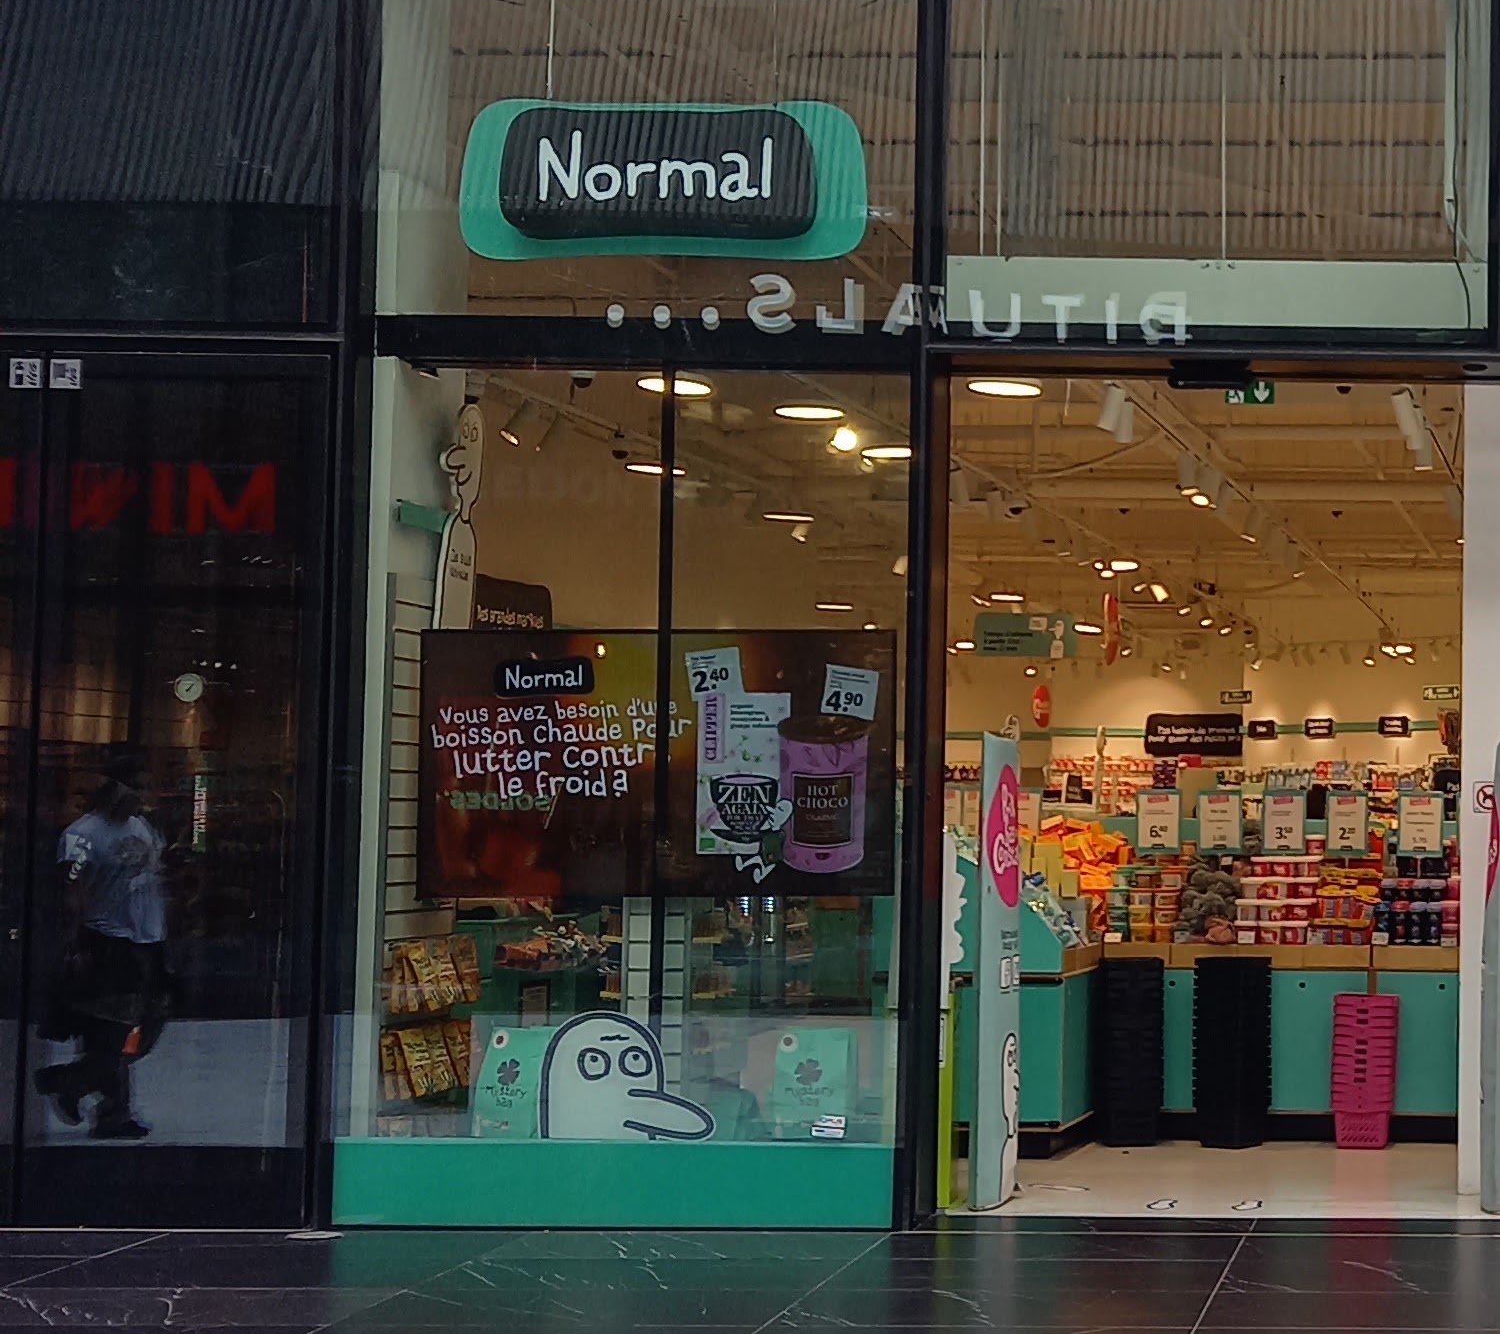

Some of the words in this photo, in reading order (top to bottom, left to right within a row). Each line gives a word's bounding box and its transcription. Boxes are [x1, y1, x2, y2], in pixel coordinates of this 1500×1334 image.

[537, 129, 774, 202] Normal
[504, 664, 583, 690] Normal
[692, 667, 729, 693] 2.40
[439, 706, 489, 725] Vous
[496, 705, 549, 723] avez
[554, 700, 620, 720] besoin
[825, 690, 864, 712] 4.90
[431, 724, 525, 749] boisson
[532, 717, 623, 744] chaude
[705, 696, 718, 761] CLIPPER
[453, 749, 552, 779] lutter
[498, 771, 523, 800] le
[717, 784, 774, 805] ZEN
[806, 784, 840, 797] HOT
[796, 796, 850, 809] CHOCO
